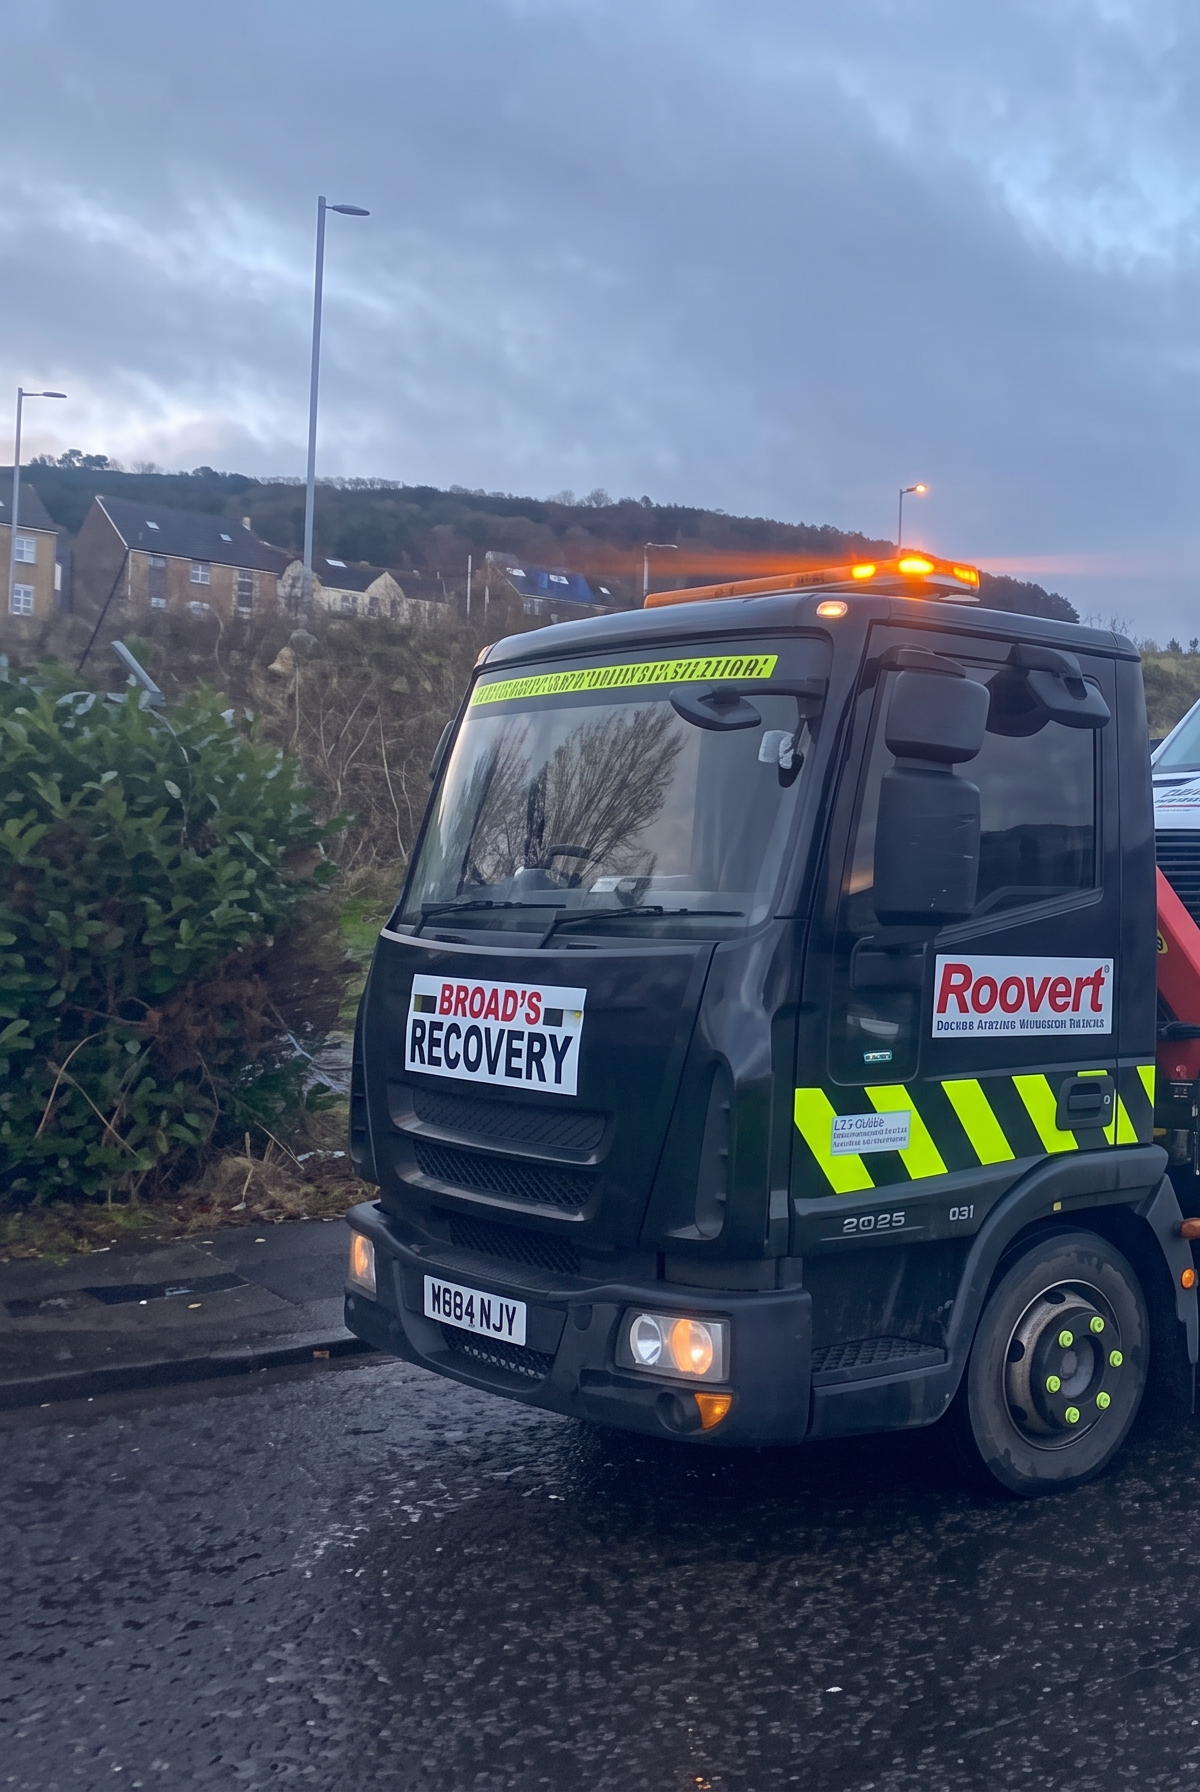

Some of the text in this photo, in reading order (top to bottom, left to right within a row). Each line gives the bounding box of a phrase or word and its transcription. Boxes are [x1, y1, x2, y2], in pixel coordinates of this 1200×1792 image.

[438, 983, 542, 1025] BROAD'S
[936, 963, 1106, 1014] Roovert
[410, 1019, 574, 1085] RECOVERY
[843, 1211, 906, 1233] 2025
[949, 1204, 974, 1221] 031
[480, 1297, 517, 1337] NJY
